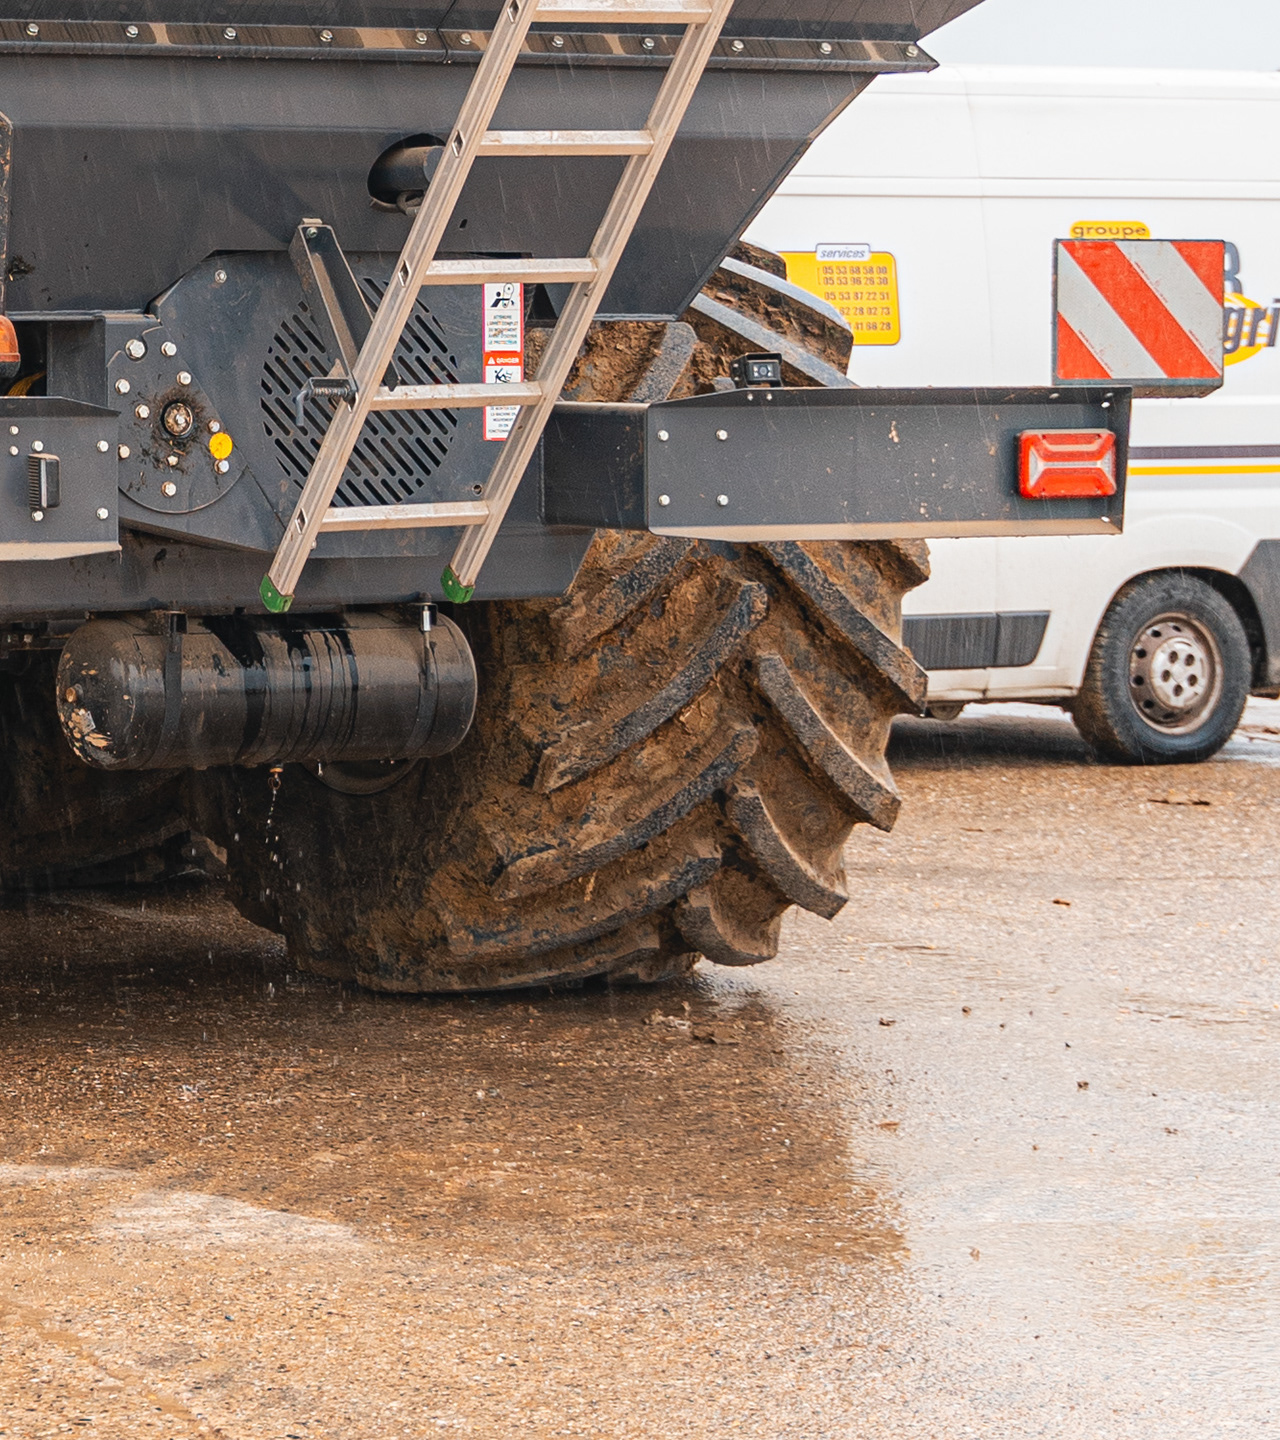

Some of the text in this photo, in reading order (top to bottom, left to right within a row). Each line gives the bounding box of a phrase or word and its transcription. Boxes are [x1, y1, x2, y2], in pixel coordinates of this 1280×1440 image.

[1073, 226, 1146, 240] groupe
[820, 249, 865, 259] services
[822, 266, 834, 275] 05
[836, 266, 847, 275] 53
[823, 276, 835, 286] 05
[837, 276, 848, 286] 53
[824, 292, 836, 301] 05
[838, 292, 850, 301] 53
[866, 292, 877, 301] 22
